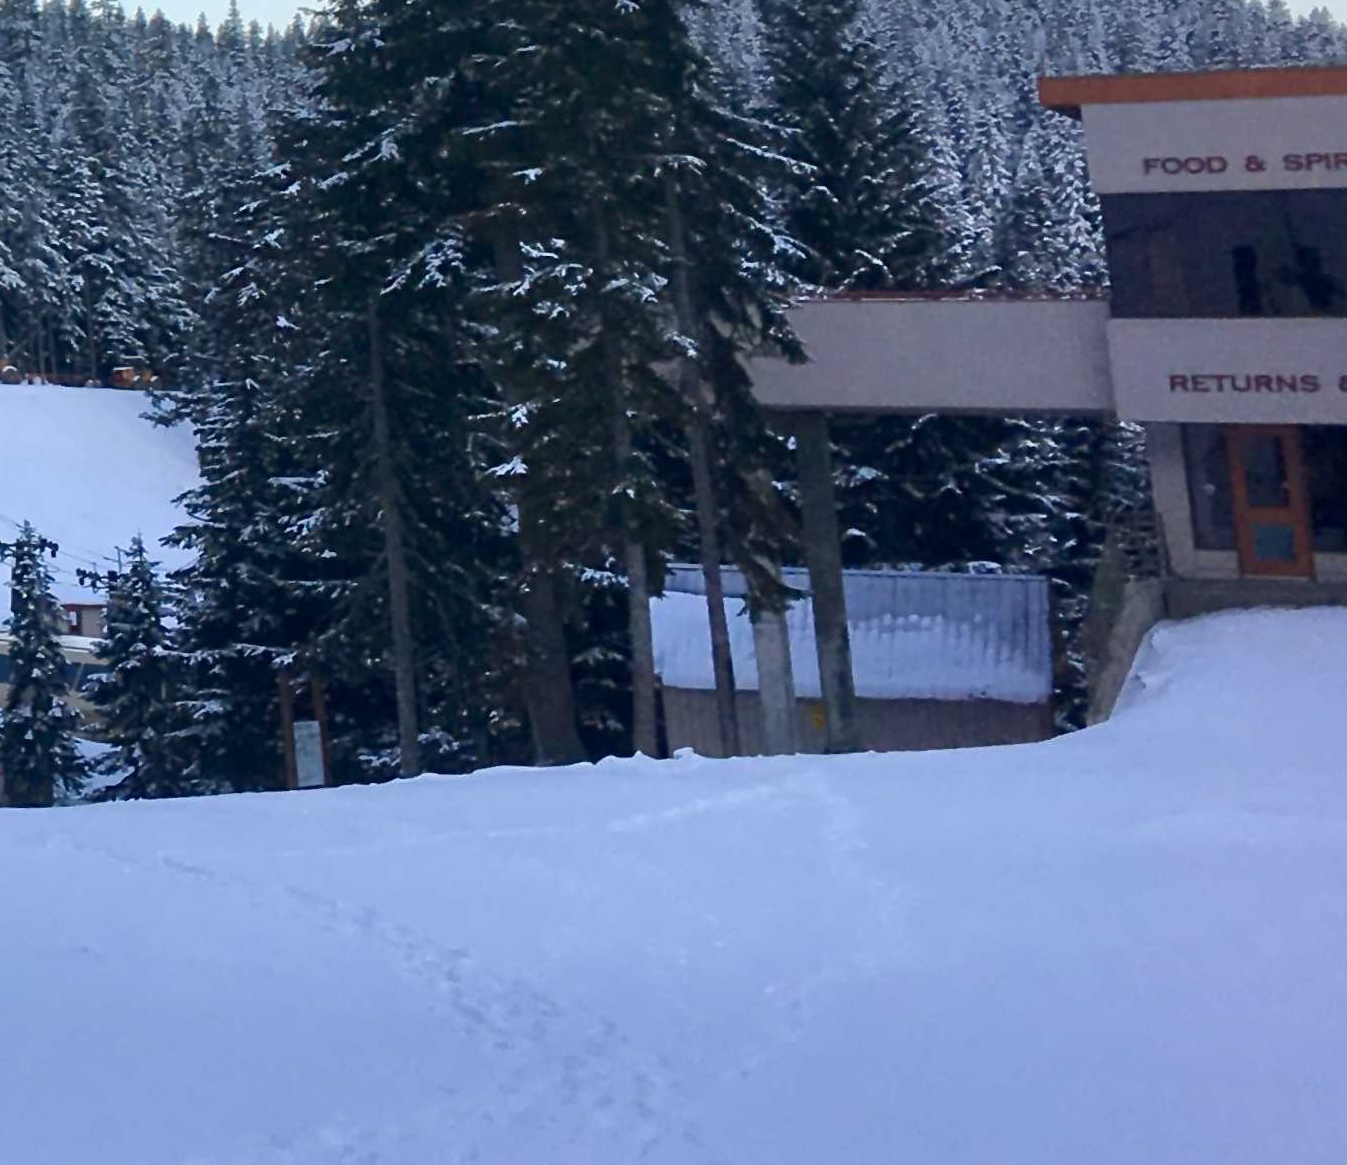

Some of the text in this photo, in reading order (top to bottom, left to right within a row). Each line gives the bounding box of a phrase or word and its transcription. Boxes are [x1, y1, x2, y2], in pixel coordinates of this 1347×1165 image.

[1142, 156, 1228, 175] FOOD
[1244, 155, 1267, 172] &
[1169, 374, 1321, 393] RETURNS
